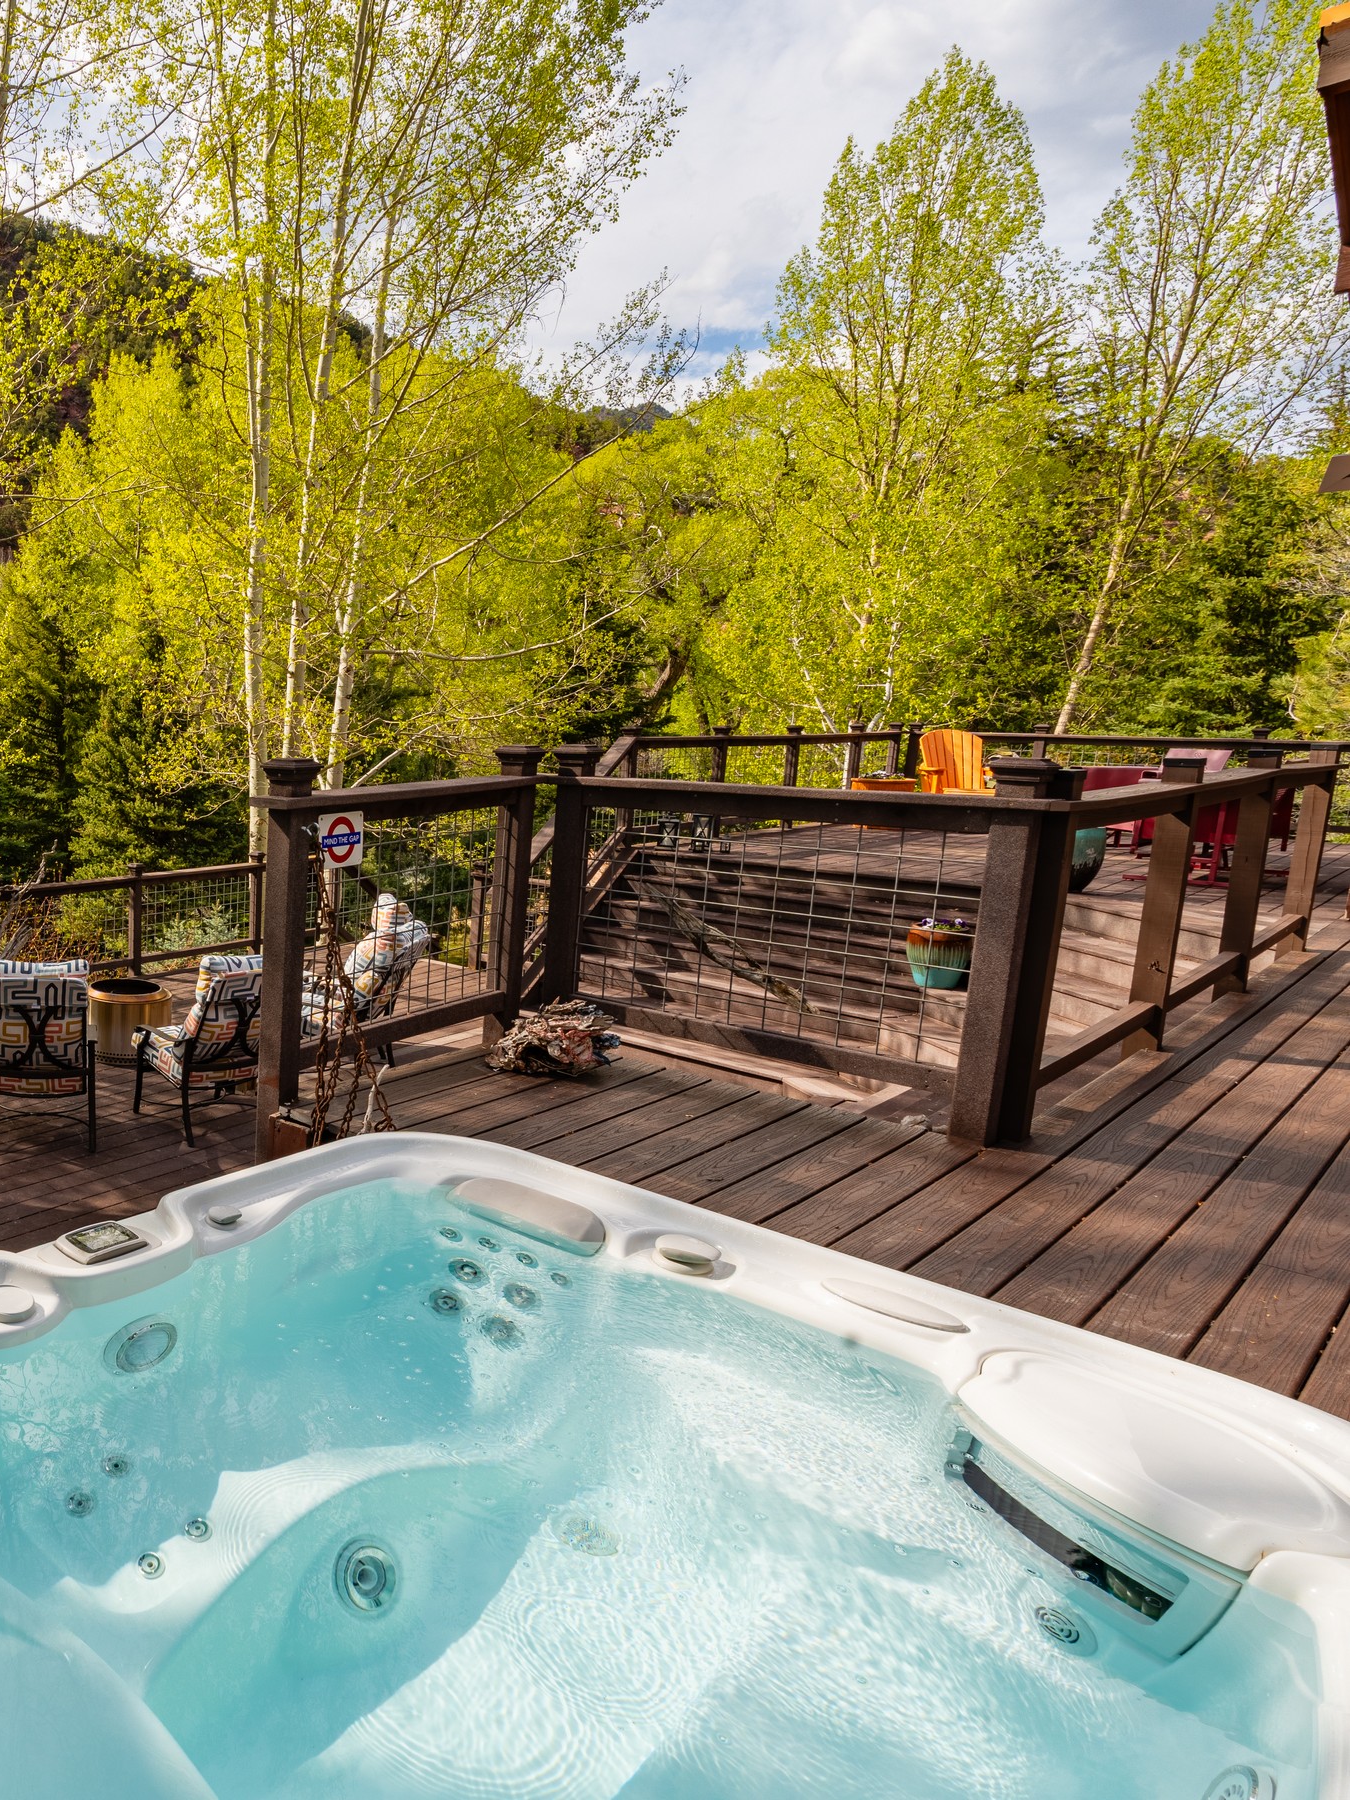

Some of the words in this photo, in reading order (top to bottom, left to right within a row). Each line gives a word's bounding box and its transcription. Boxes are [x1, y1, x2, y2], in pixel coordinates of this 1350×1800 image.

[323, 837, 338, 845] MIND
[338, 835, 348, 844] THE
[349, 834, 359, 842] GAP
